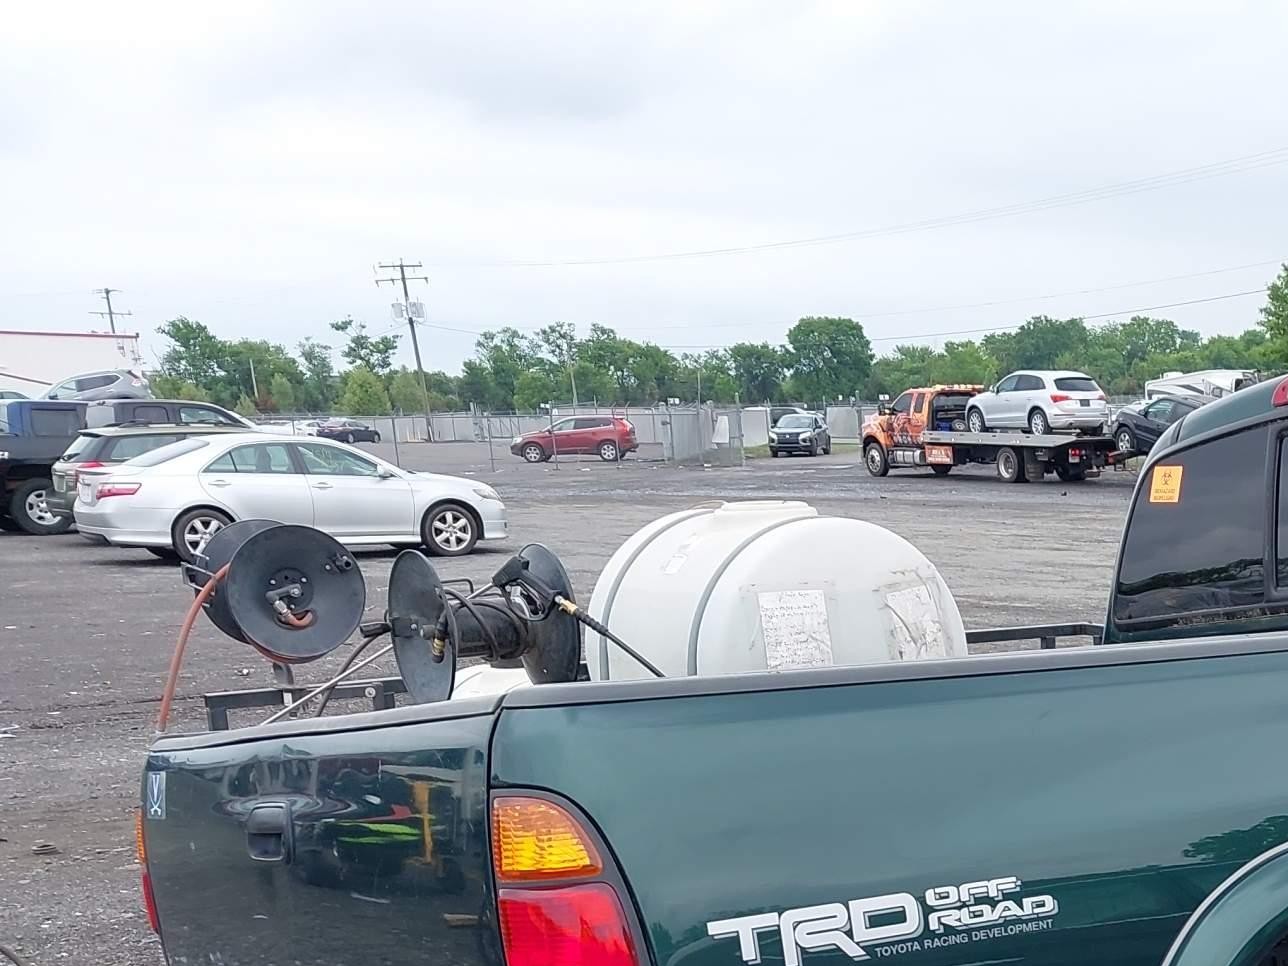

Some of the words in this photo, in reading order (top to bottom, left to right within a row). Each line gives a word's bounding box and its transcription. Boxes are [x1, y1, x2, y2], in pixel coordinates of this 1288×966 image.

[924, 876, 1022, 908] OFF
[928, 894, 1060, 932] ROAD
[875, 941, 921, 958] TOYOTA
[924, 933, 968, 950] RACING
[972, 919, 1054, 941] DEVELOPMENT
